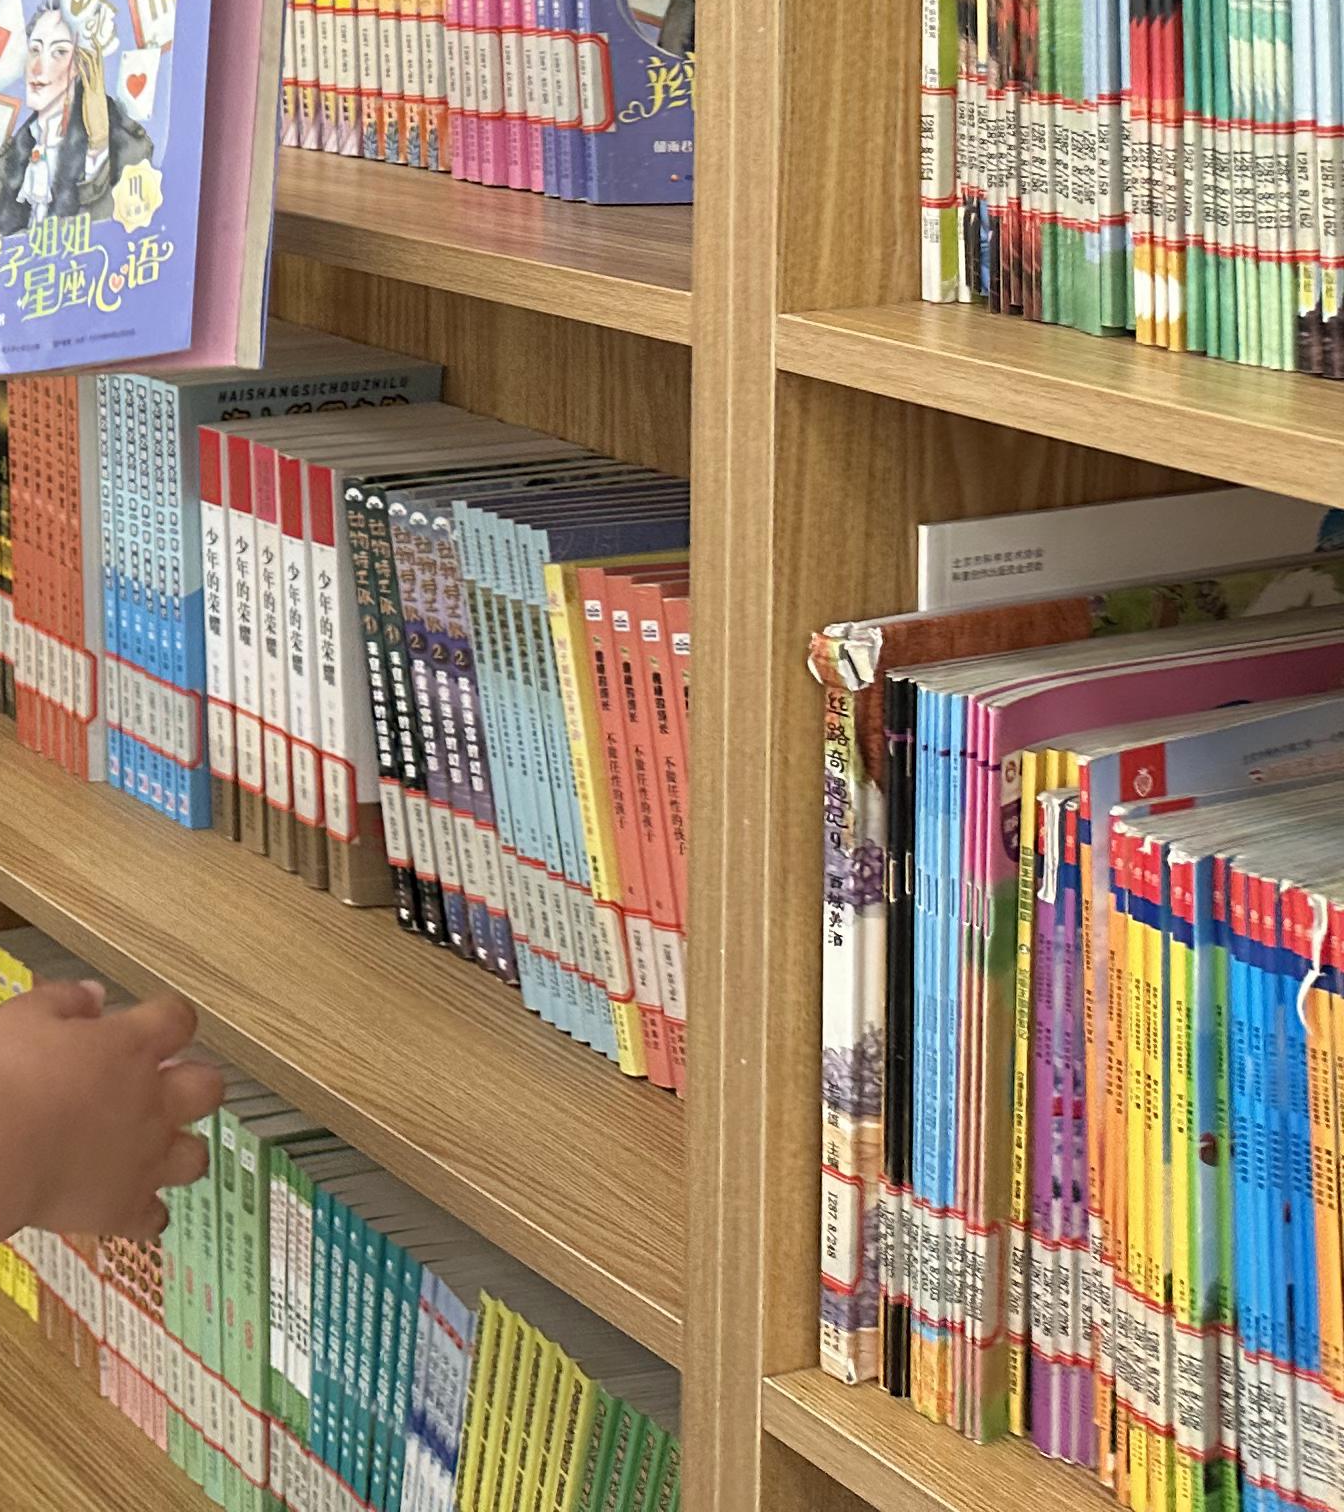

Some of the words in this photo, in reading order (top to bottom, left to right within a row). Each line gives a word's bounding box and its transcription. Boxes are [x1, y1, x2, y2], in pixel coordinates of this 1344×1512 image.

[20, 234, 174, 322] 星座心语
[206, 528, 222, 637] 少年的荣耀
[235, 535, 252, 648] 少年的荣耀
[262, 546, 278, 659] 少年的荣耀
[288, 562, 304, 677] 少年的荣耀
[318, 569, 336, 687] 少年的荣耀
